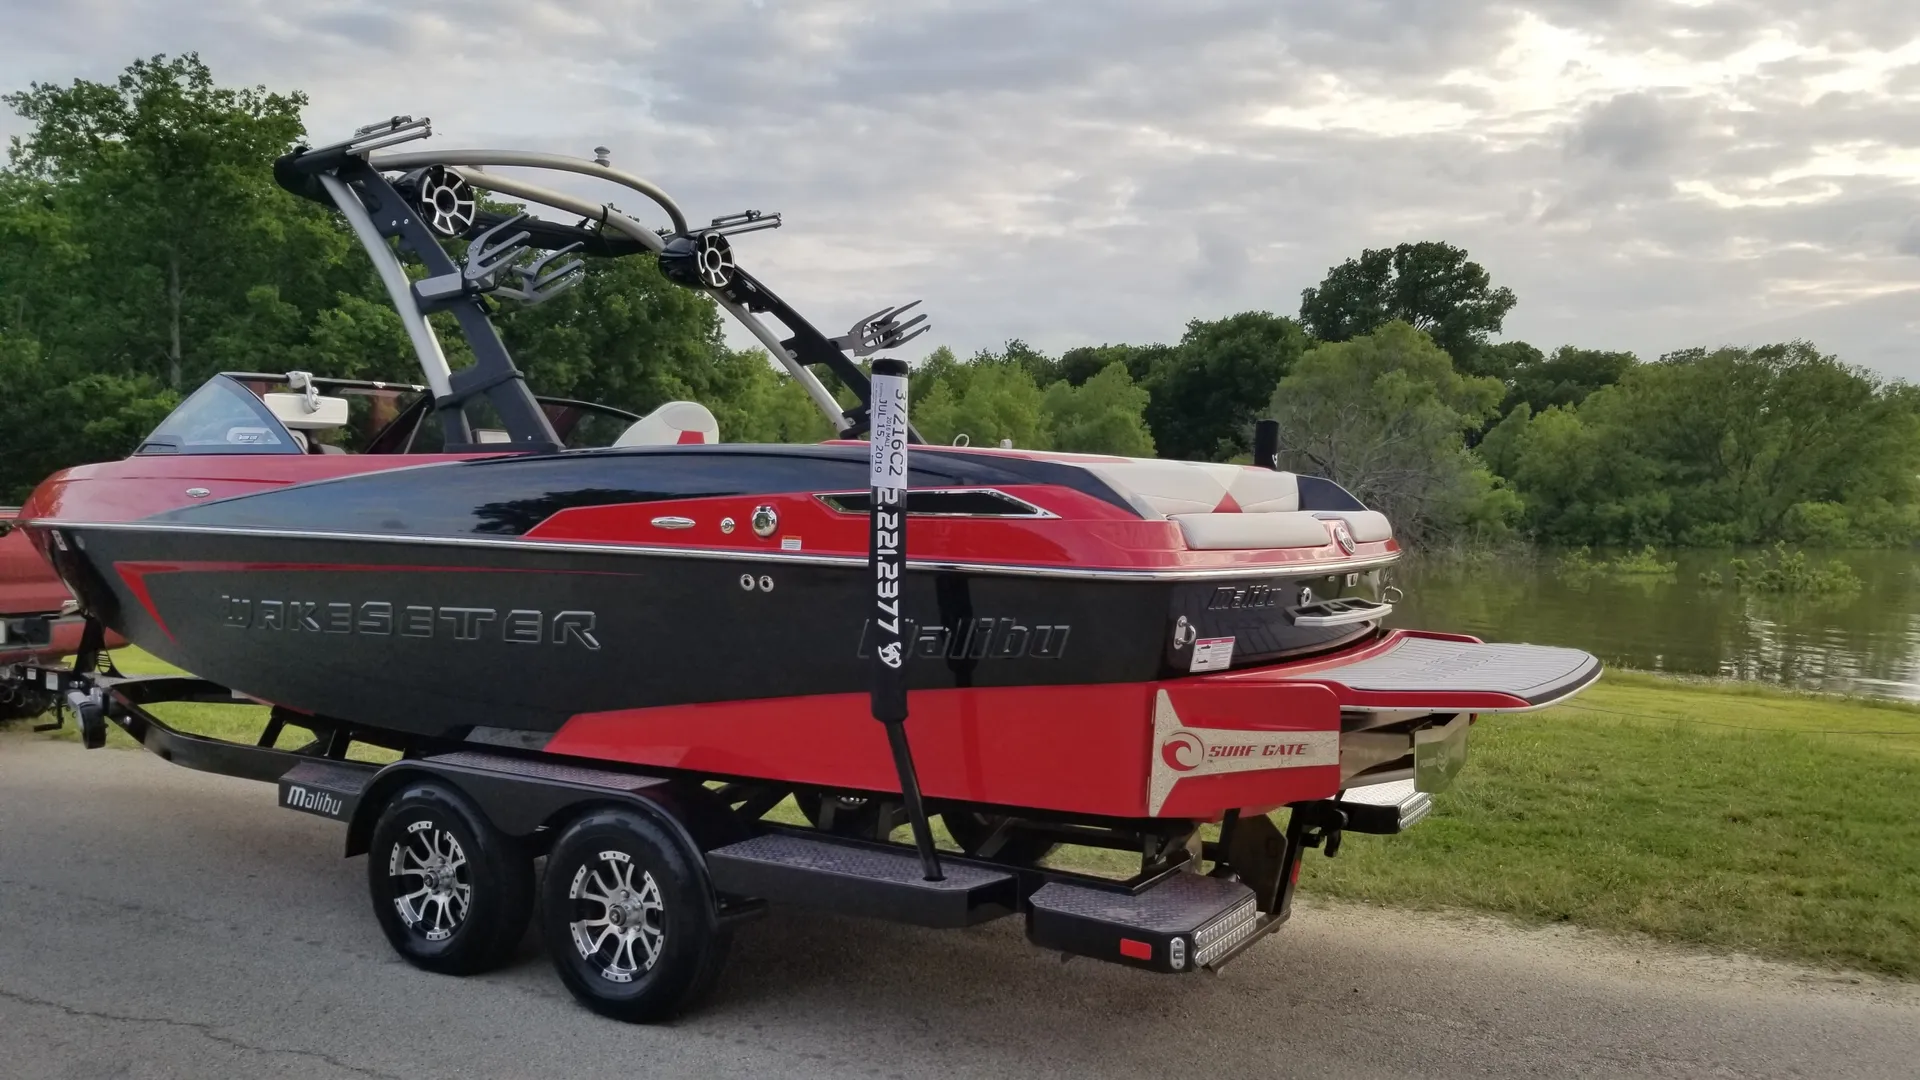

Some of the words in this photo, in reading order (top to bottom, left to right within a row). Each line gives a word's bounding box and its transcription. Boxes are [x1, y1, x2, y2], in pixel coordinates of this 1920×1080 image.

[877, 399, 887, 419] JUL
[875, 424, 884, 440] 15,
[889, 389, 907, 476] 37216C2
[874, 445, 883, 473] 2019
[221, 595, 601, 650] WAKESETTER
[1208, 745, 1257, 757] SURF
[1262, 744, 1308, 756] GATE
[287, 785, 342, 815] Malibu
